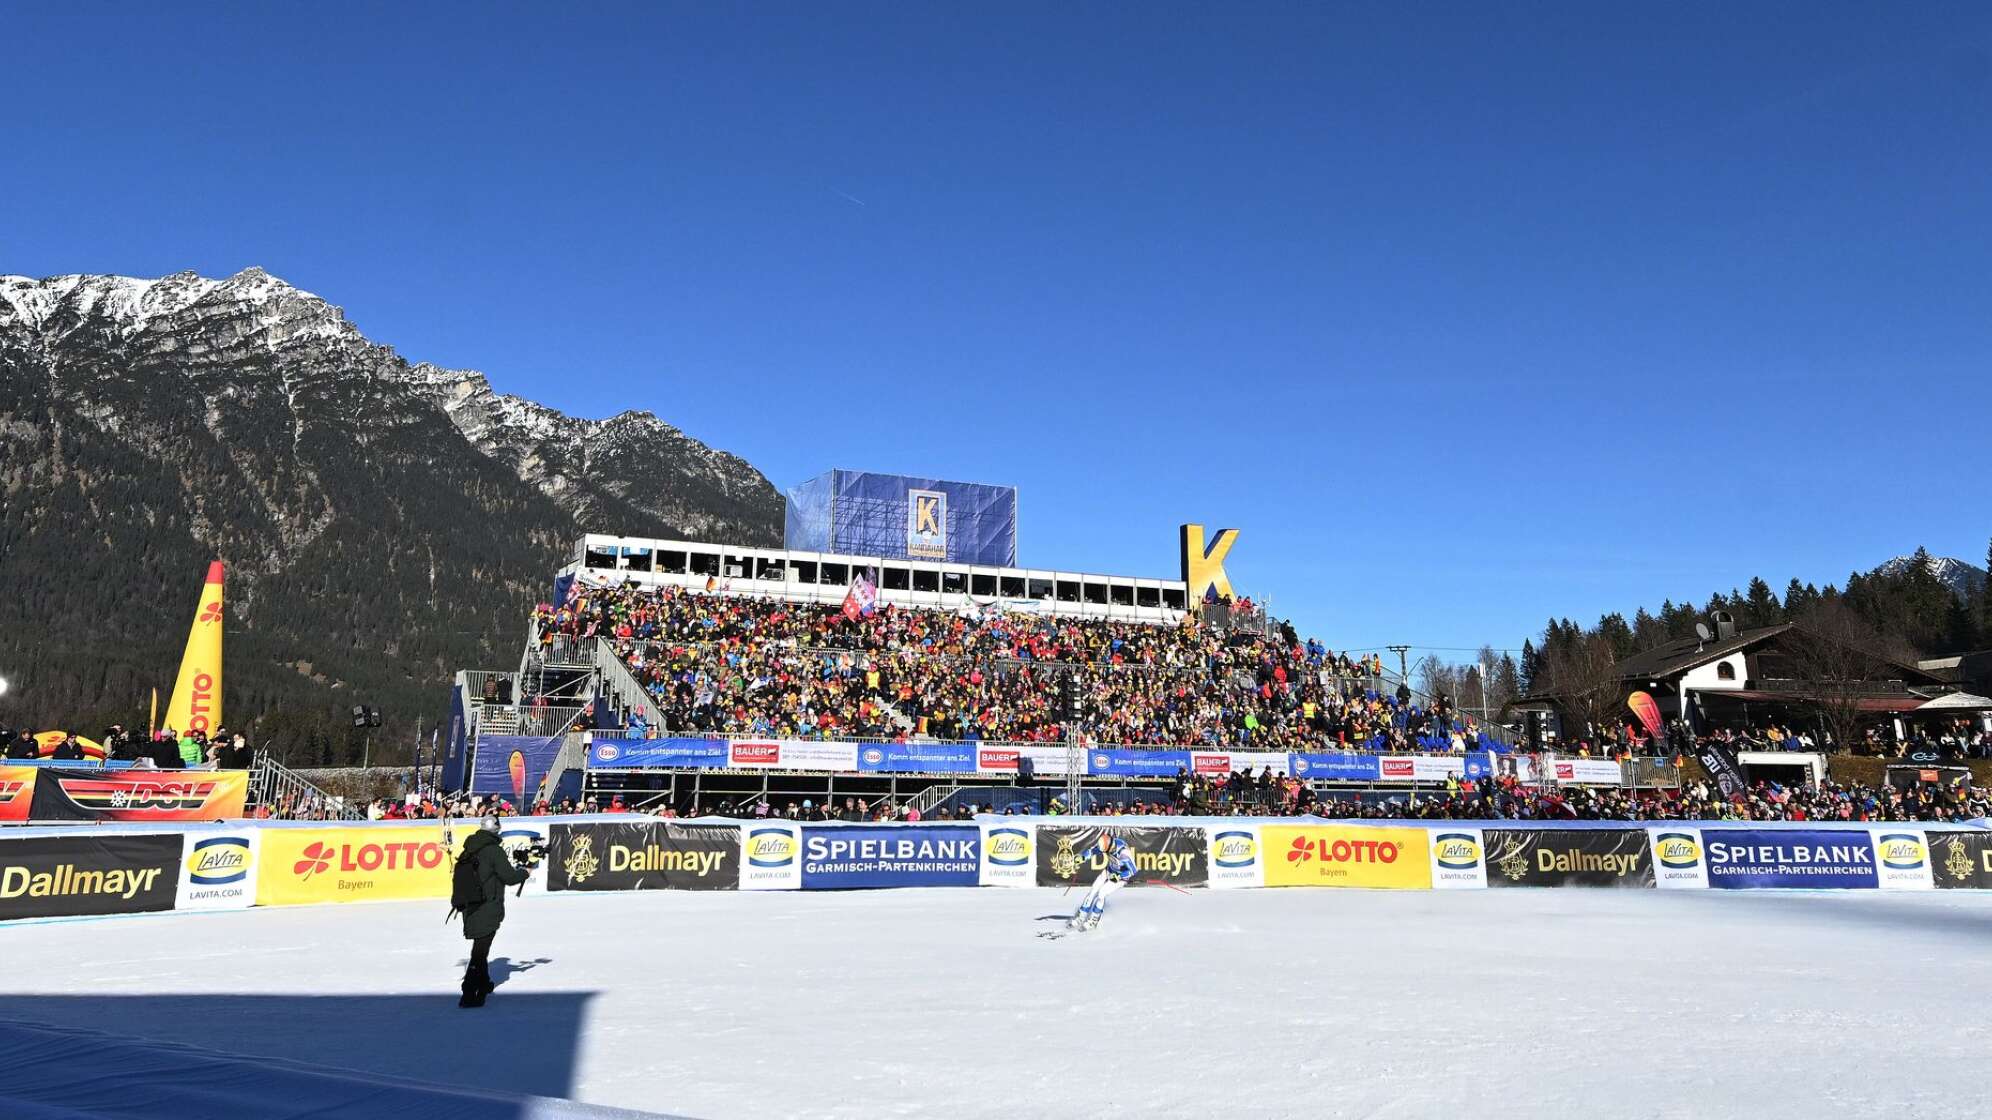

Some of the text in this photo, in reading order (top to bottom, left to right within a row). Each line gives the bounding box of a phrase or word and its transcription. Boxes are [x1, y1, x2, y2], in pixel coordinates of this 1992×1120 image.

[916, 496, 939, 536] K
[1180, 524, 1240, 606] K
[190, 673, 212, 734] OTTO
[735, 747, 768, 756] BAUER
[981, 753, 1011, 761] BAUER
[341, 842, 444, 871] LOTTO
[610, 844, 726, 876] Dallmayr
[807, 836, 976, 861] SPIELBANK
[1710, 842, 1870, 863] SPIELBANK
[807, 862, 976, 874] GARMISCH-PARTENKIRCHEN
[1320, 867, 1347, 877] Bayern
[1537, 848, 1639, 877] Dallmayr
[1712, 865, 1873, 876] GARMISCH-PARTENKIRCHEN
[0, 864, 162, 900] Dallmayr
[338, 879, 373, 890] Bayern
[190, 889, 243, 900] LAVITA.COM
